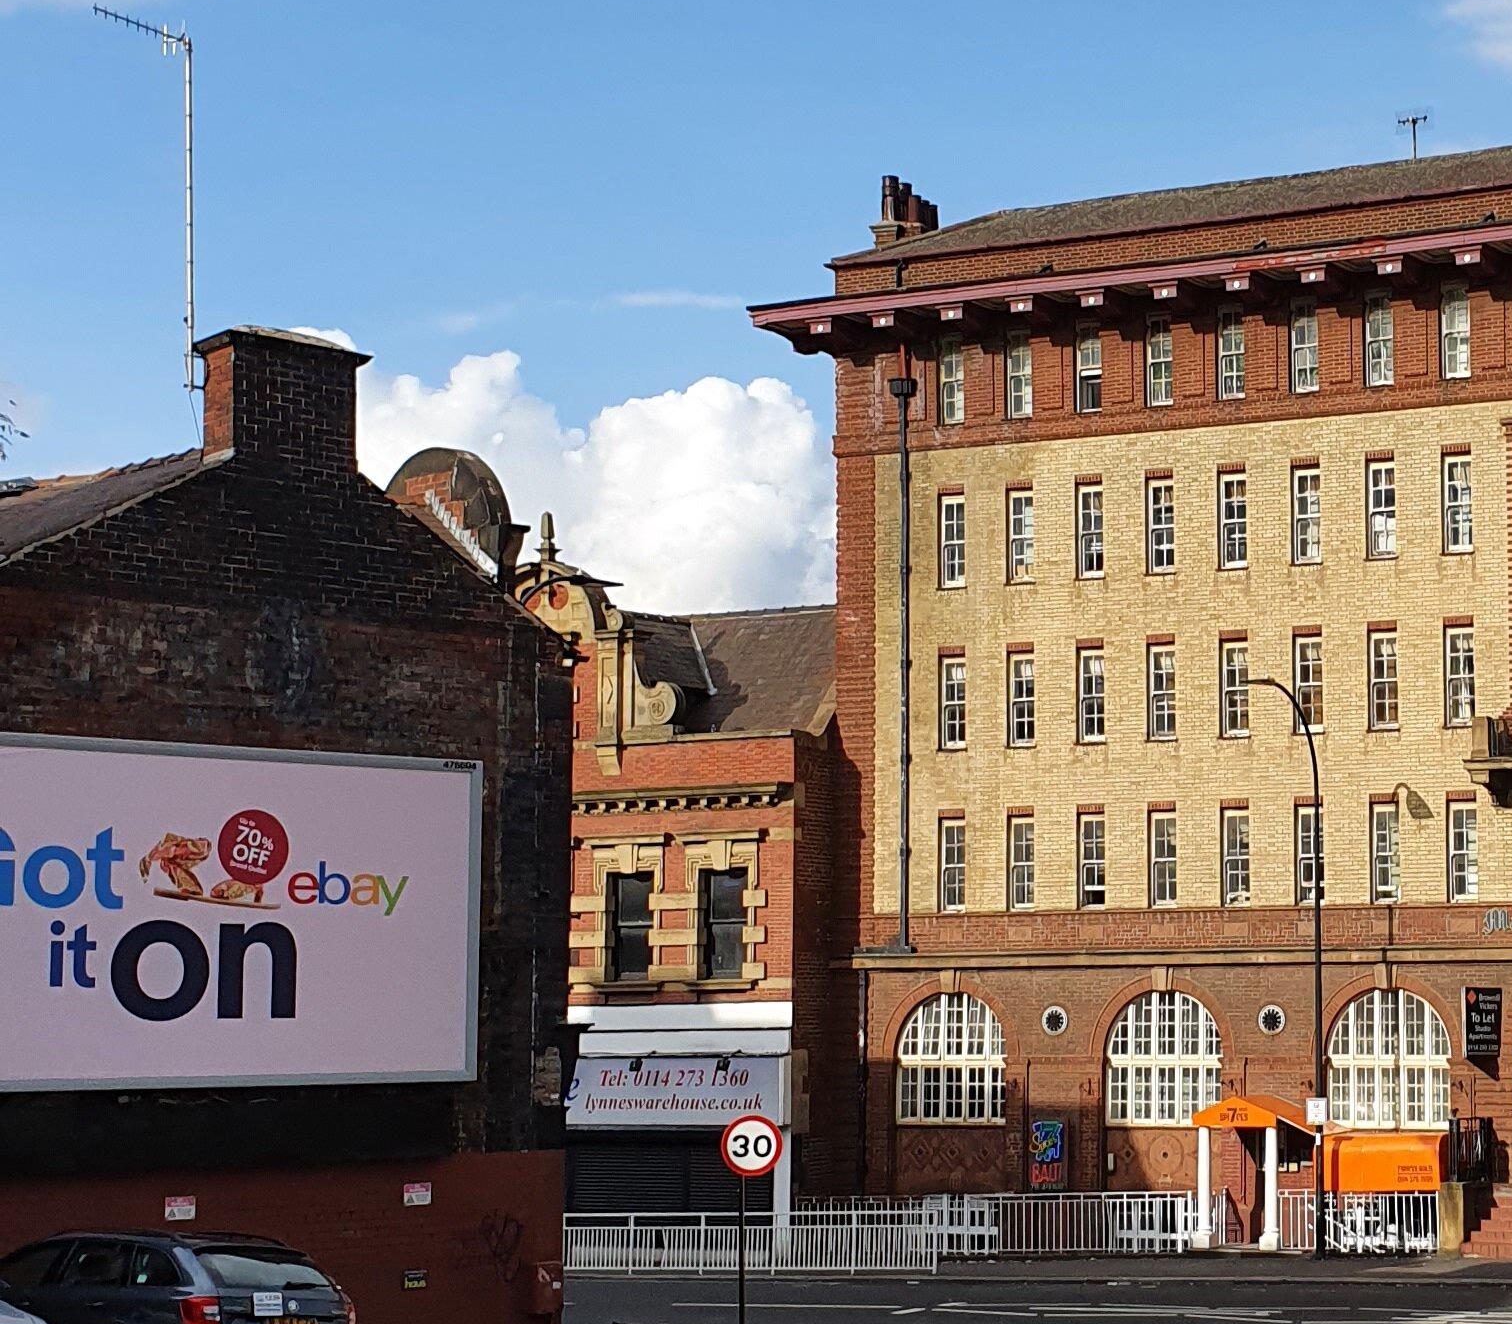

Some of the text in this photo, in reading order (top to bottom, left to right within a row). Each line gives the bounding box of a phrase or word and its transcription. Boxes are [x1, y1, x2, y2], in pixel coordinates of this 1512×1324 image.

[236, 825, 274, 851] 70%
[232, 844, 271, 866] OFF
[0, 825, 125, 910] ot
[287, 860, 409, 916] ebay
[49, 919, 297, 1021] it on
[1471, 1012, 1495, 1023] To Let
[1475, 1024, 1492, 1032] Studio
[600, 1068, 750, 1087] Tel: 0114 273 1360
[585, 1093, 764, 1114] lynneswarehouse.co.uk
[731, 1134, 773, 1158] 30
